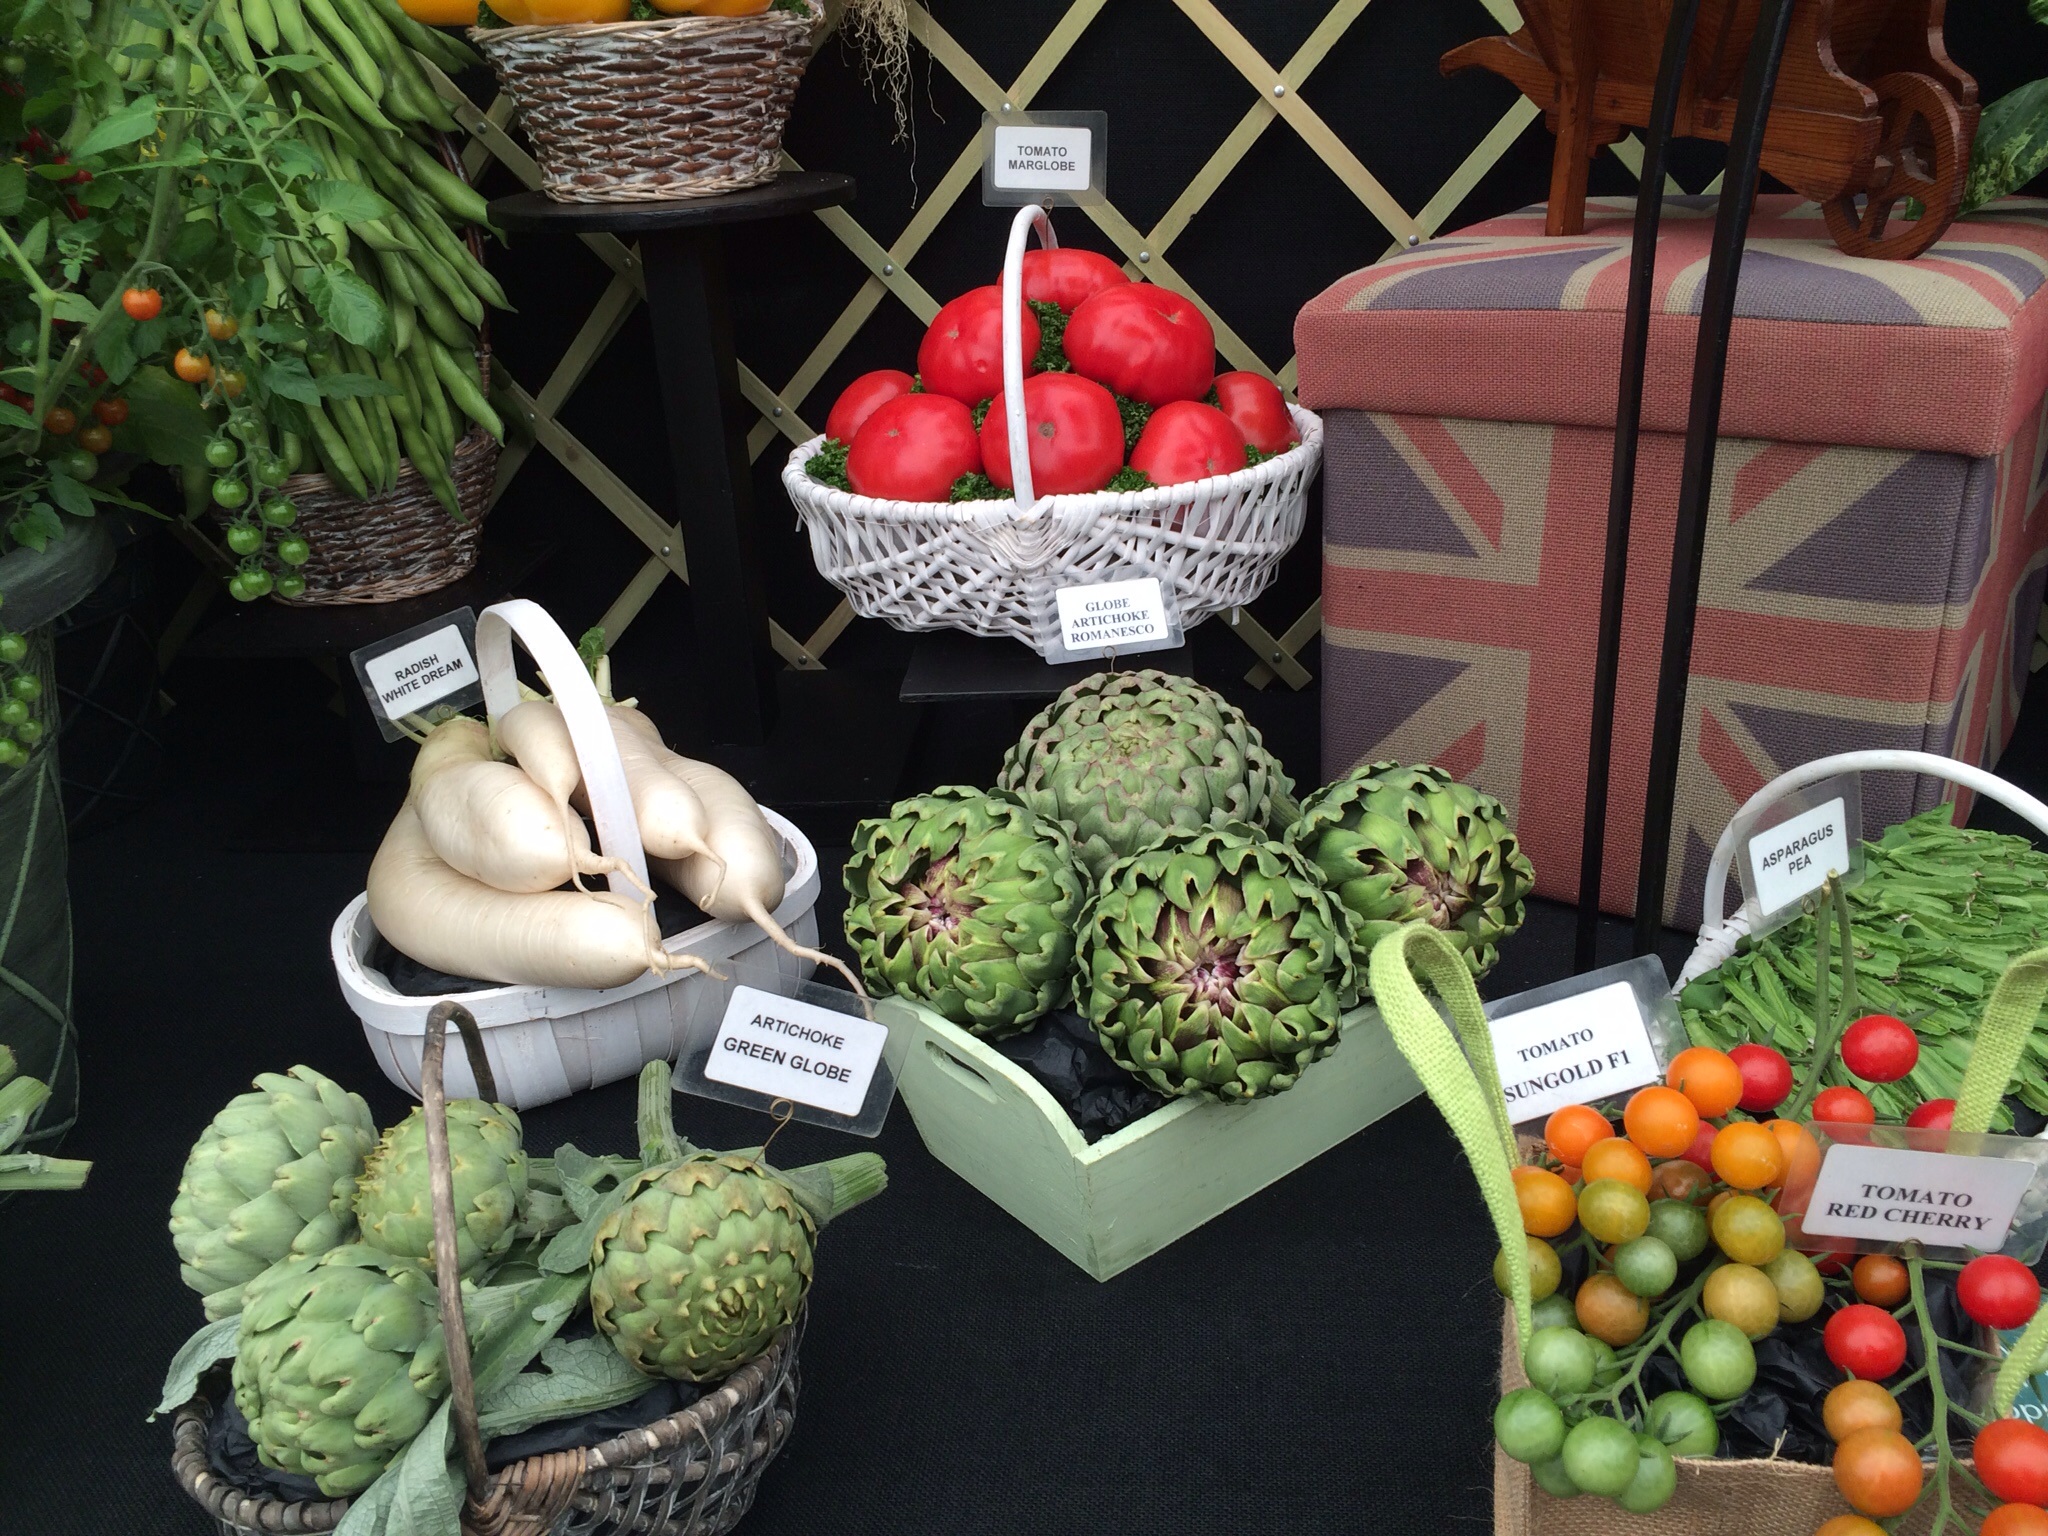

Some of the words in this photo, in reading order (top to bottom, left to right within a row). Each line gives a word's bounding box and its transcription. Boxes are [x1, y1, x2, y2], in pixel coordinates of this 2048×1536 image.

[1008, 159, 1076, 171] MARGLOBE
[1017, 145, 1068, 157] TOMATO
[1085, 598, 1131, 612] GLOBE
[1070, 623, 1155, 643] ROMANESCO
[1071, 610, 1150, 629] ARTICHOKE
[381, 679, 421, 704] WHITE
[421, 658, 464, 685] DREAM
[394, 654, 440, 682] RADISH
[1762, 824, 1834, 871] ASPARAGUS
[1788, 854, 1812, 876] PEA
[750, 1014, 845, 1050] ARTICHOKE
[1517, 1028, 1594, 1063] TOMATO
[723, 1036, 786, 1065] GREEN
[789, 1055, 852, 1084] GLOBE
[1502, 1058, 1604, 1103] SUNGOLD
[1606, 1049, 1631, 1070] F1
[1861, 1183, 1973, 1208] TOMATO
[1825, 1202, 1878, 1220] RED
[1884, 1207, 1993, 1232] CHERRY
